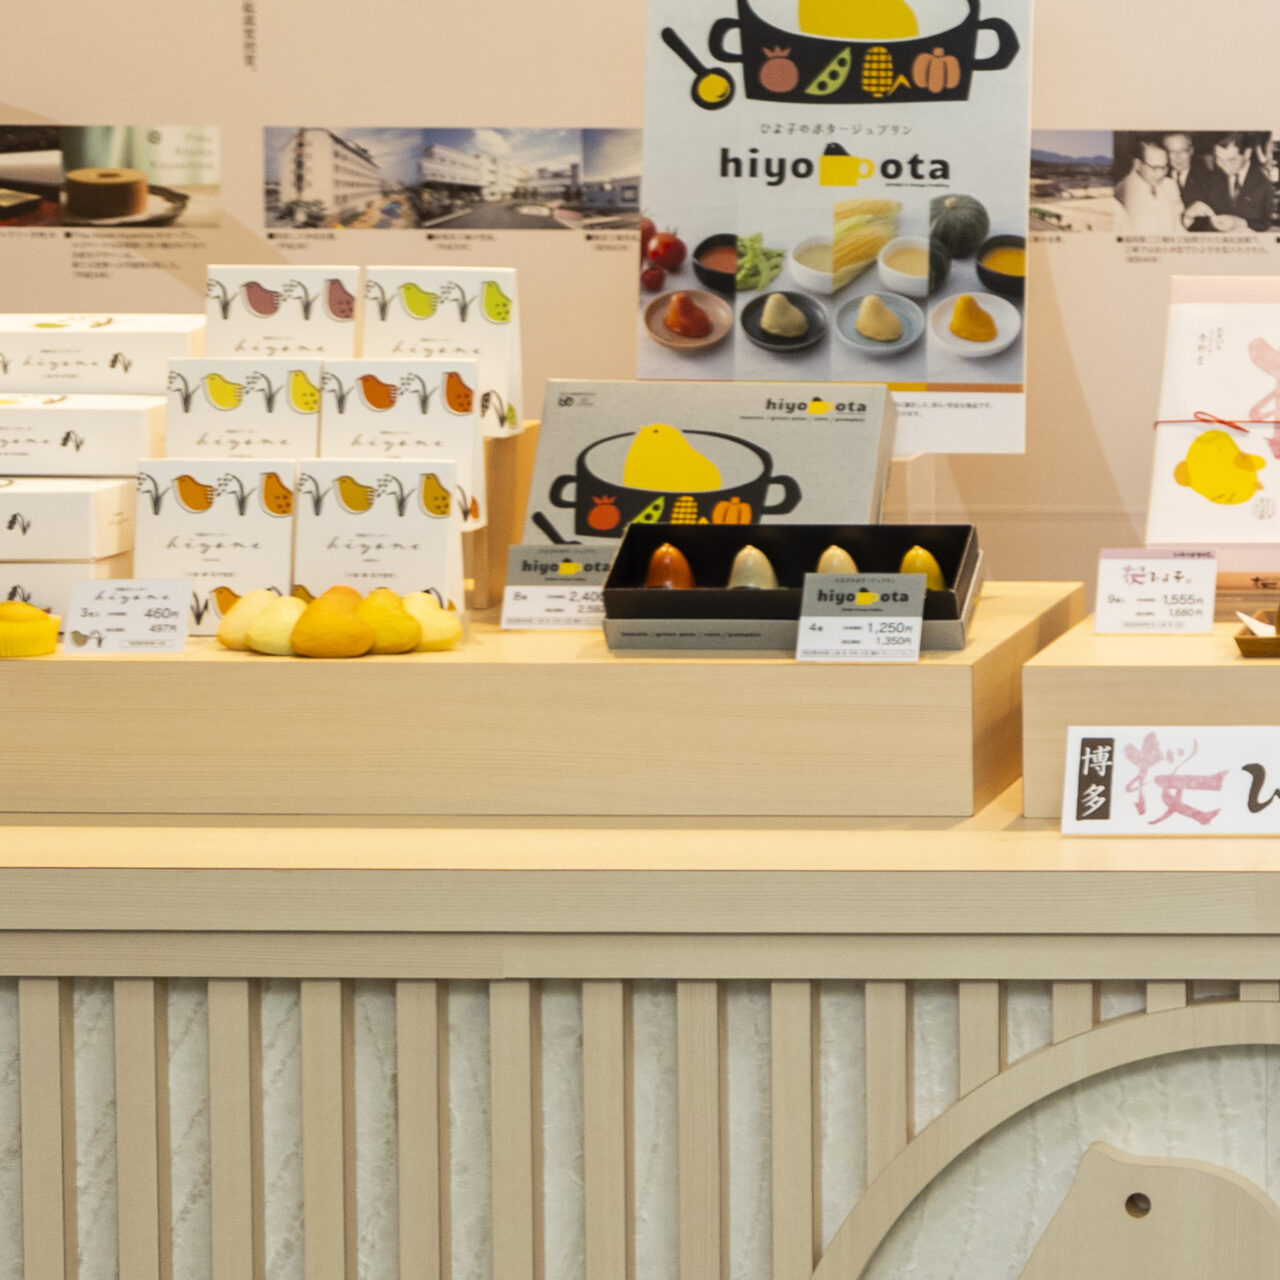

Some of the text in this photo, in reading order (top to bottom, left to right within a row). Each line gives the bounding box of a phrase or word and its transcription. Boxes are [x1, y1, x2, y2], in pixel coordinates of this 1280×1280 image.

[760, 122, 913, 136] ひよ子のポタージュプリン
[1163, 594, 1204, 606] 1,555円
[867, 622, 913, 634] 1,250円
[1081, 746, 1113, 817] 博多
[1123, 730, 1231, 827] 桜
